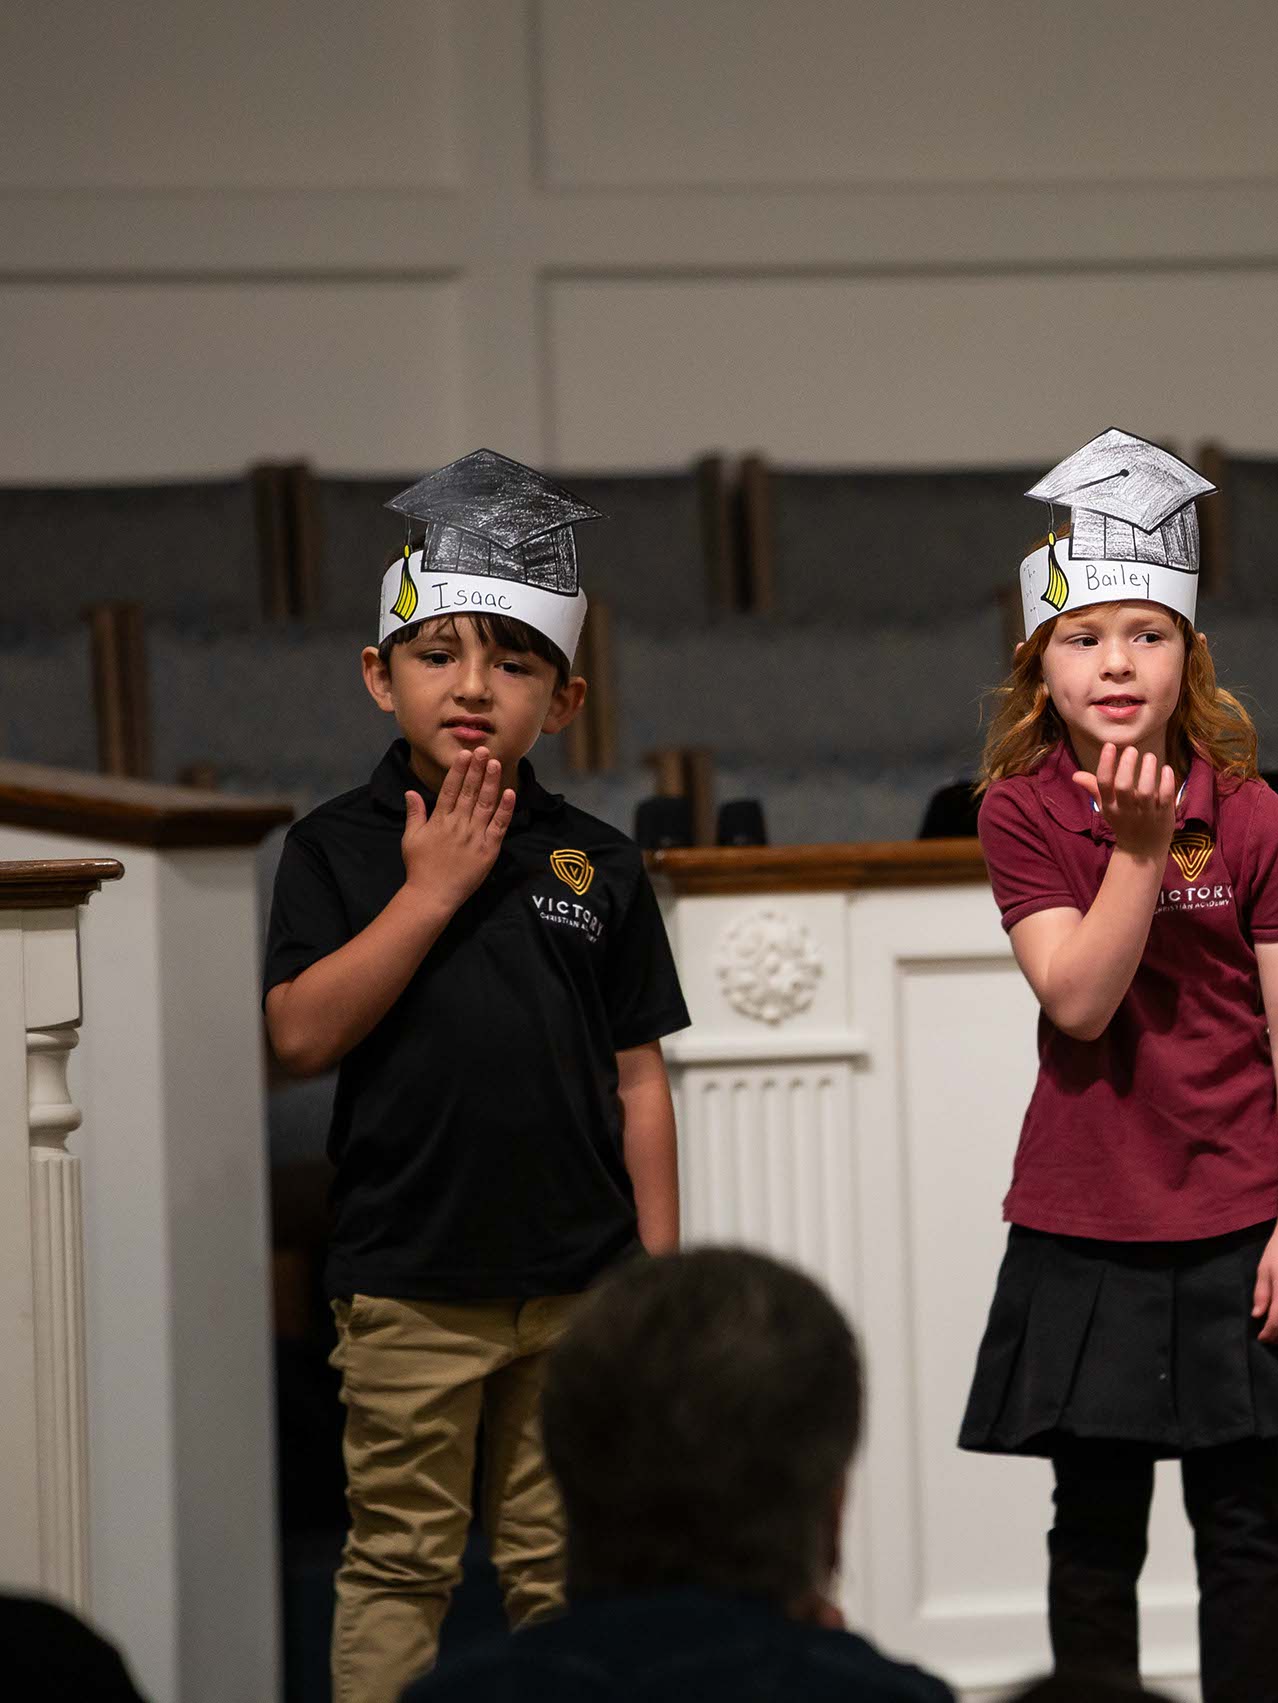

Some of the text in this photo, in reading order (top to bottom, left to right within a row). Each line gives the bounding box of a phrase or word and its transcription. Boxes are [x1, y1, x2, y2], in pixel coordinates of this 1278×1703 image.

[431, 582, 513, 612] Isaac
[1085, 564, 1150, 599] Bailey
[1160, 884, 1232, 905] ICTORY
[532, 895, 604, 937] VICTORY
